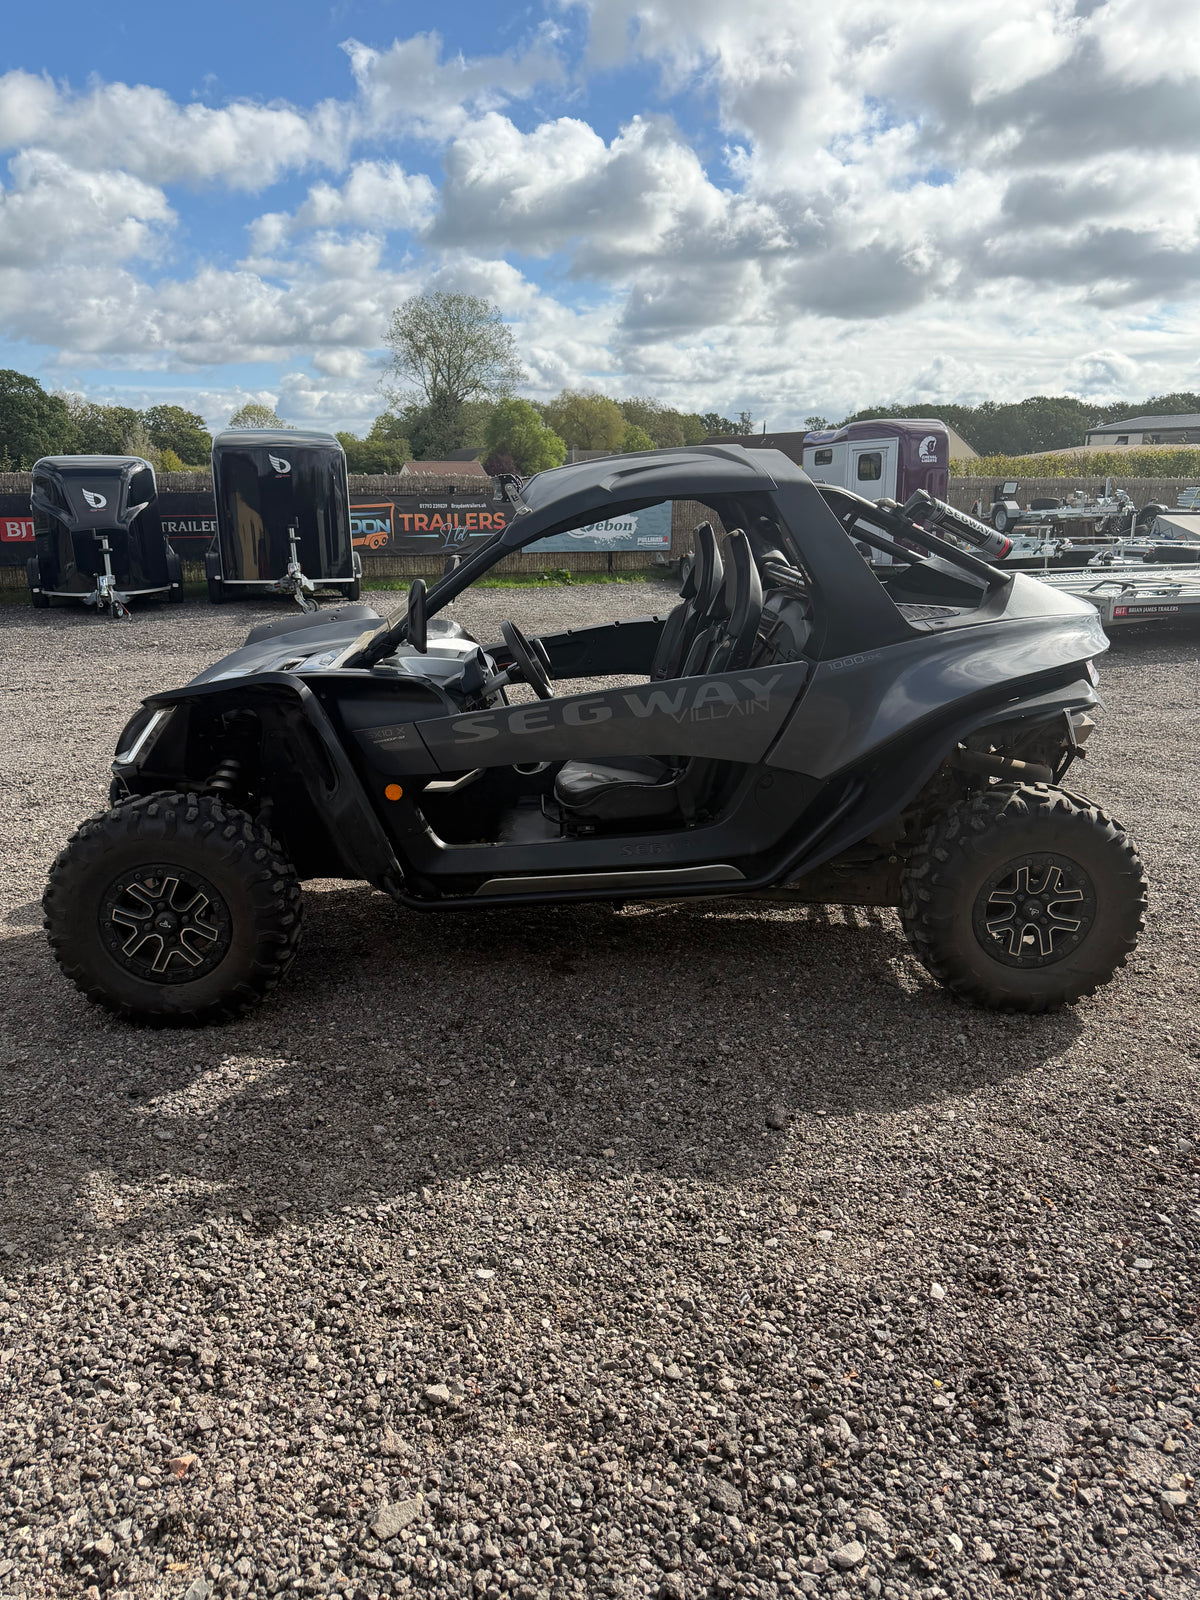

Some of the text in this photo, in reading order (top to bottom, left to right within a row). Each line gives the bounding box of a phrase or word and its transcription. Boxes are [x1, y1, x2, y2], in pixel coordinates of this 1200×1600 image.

[5, 521, 36, 539] BJT
[399, 512, 506, 532] TRAILERS
[946, 506, 992, 536] SEGWAY
[439, 522, 469, 549] Ltd
[827, 655, 865, 671] 1000
[451, 673, 784, 744] SEGWAY
[670, 699, 770, 724] VILLAIN
